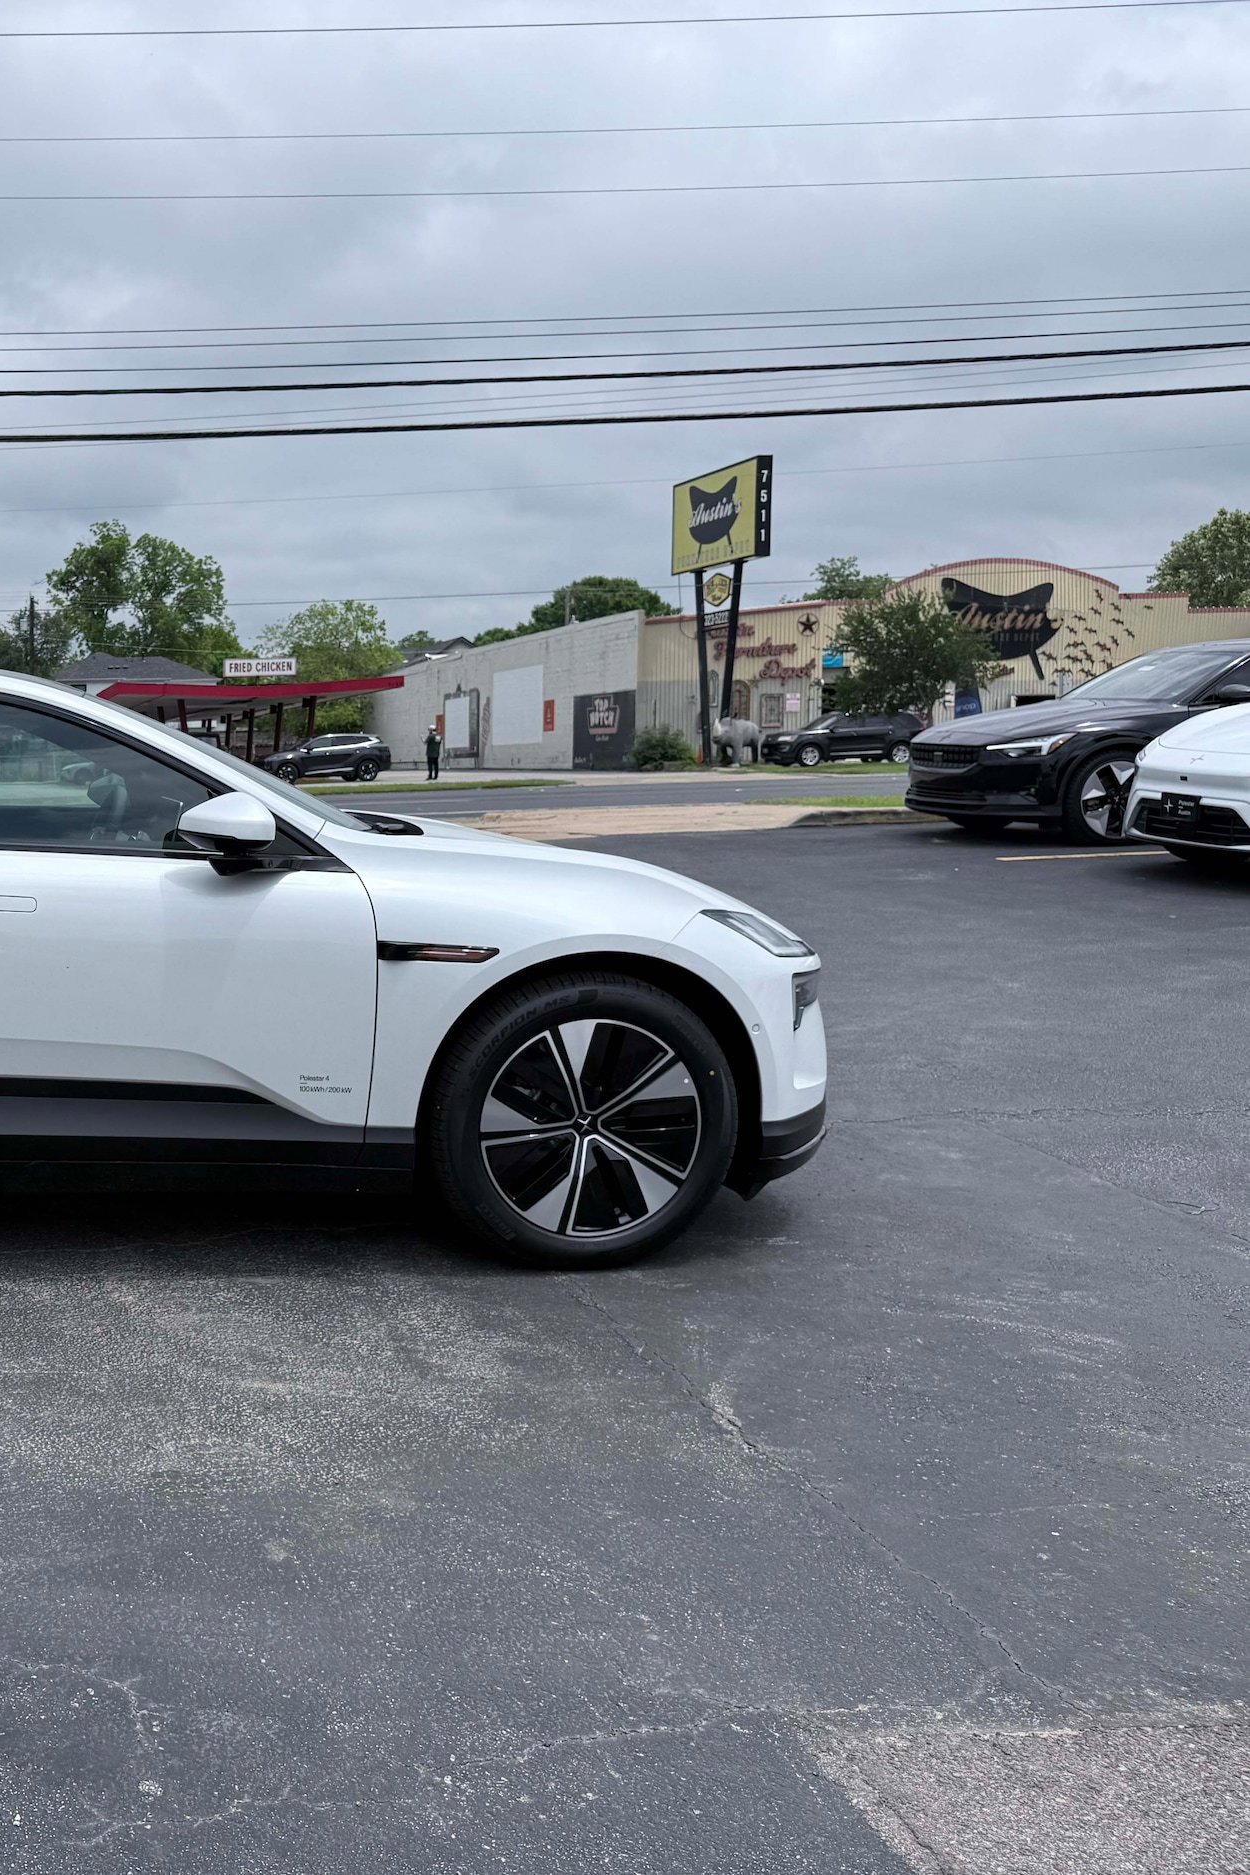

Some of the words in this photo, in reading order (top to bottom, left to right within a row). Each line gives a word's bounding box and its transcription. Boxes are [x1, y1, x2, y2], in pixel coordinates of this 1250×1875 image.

[688, 493, 742, 528] Austin's
[713, 636, 798, 661] Frniture
[229, 662, 252, 672] FRIED
[255, 661, 293, 672] CHICKEN
[759, 657, 816, 687] Depot
[594, 698, 609, 712] TOP
[589, 709, 615, 727] NOTCH
